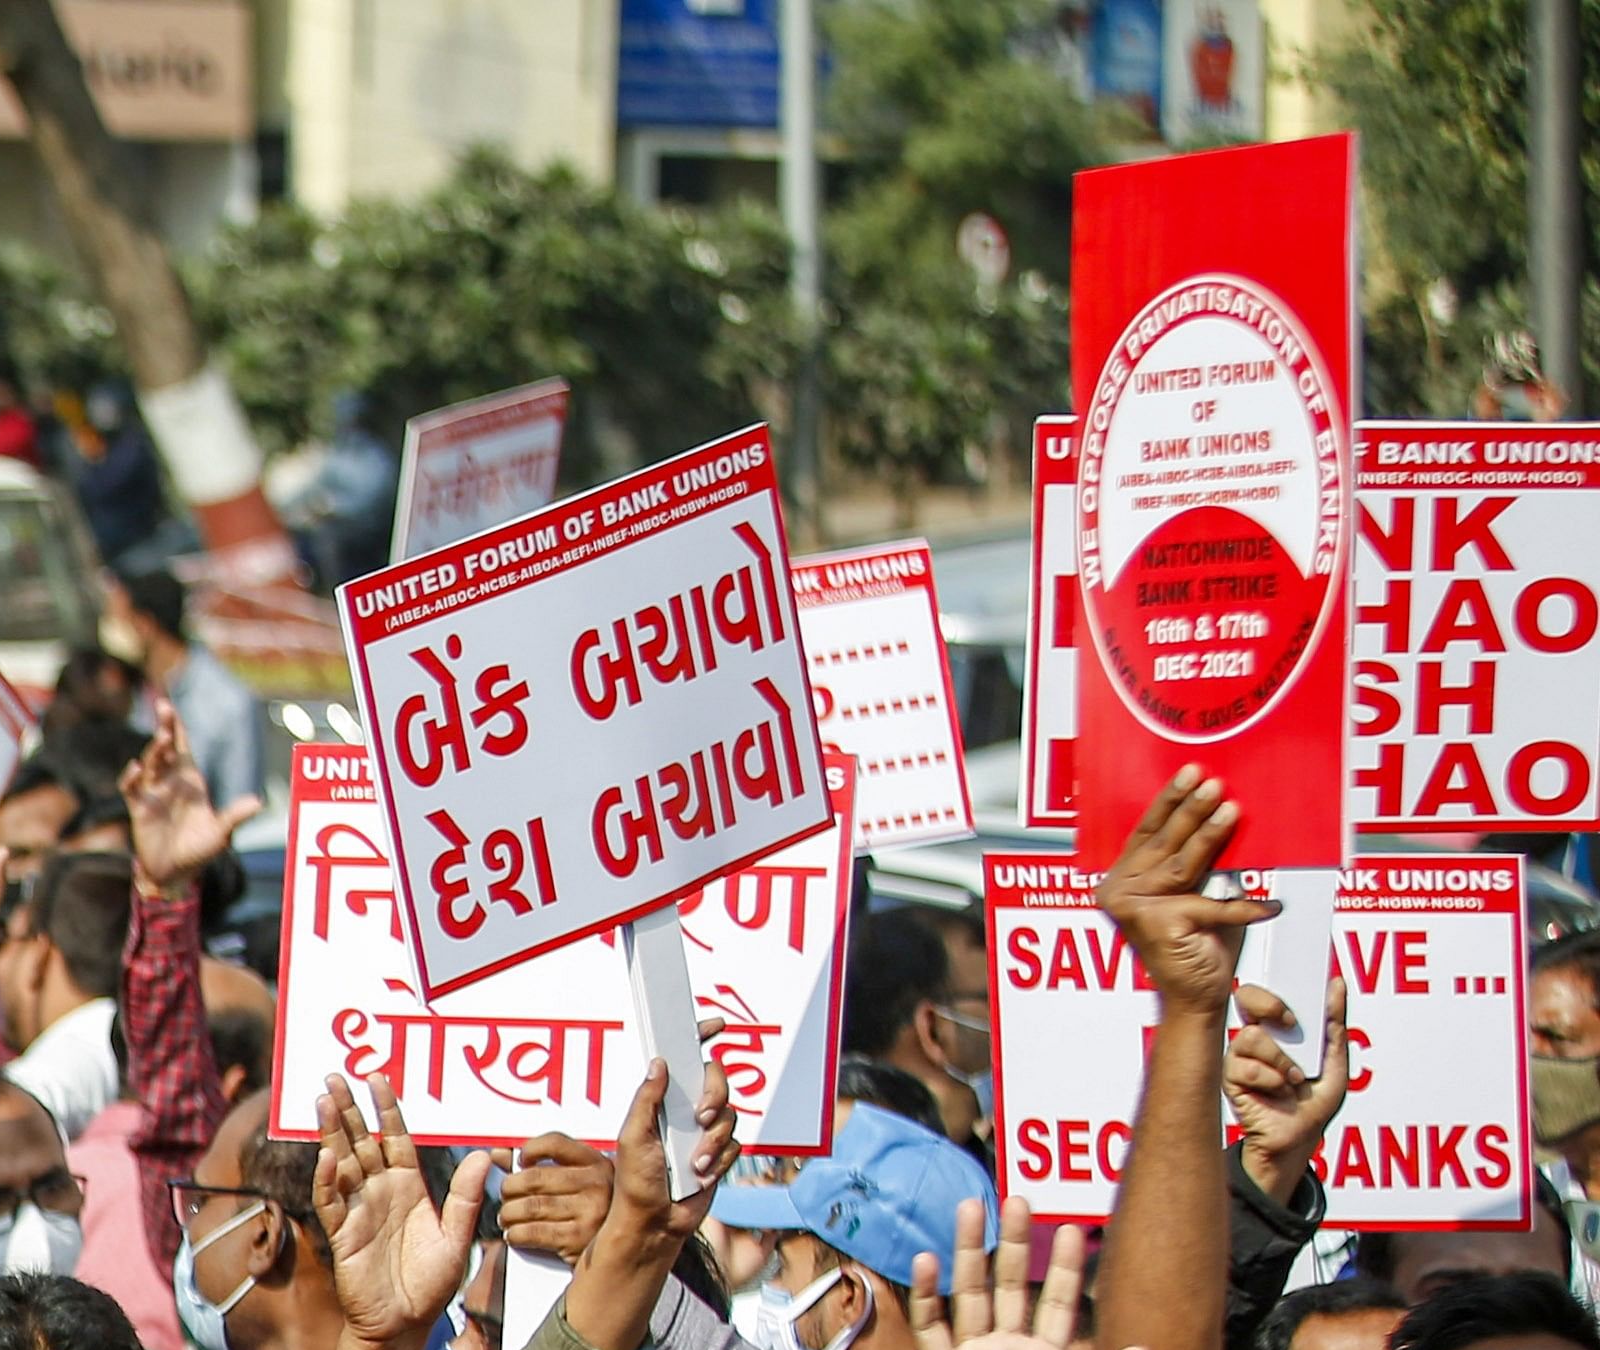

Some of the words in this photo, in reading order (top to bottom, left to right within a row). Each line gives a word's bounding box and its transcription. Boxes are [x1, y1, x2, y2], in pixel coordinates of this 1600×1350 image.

[1126, 287, 1301, 368] PRIVATISATION
[1135, 367, 1201, 394] UNITED
[1208, 360, 1274, 387] FORUM
[1299, 371, 1324, 416] OF
[1191, 400, 1216, 422] OF
[1081, 360, 1128, 513] OPPOSE
[1141, 440, 1190, 463] BANK
[1199, 431, 1271, 456] UNIONS
[1378, 441, 1476, 465] BANK
[1315, 429, 1339, 576] BANKS
[355, 562, 457, 619] UNITED
[463, 525, 557, 581] FORUM
[563, 510, 595, 541] OF
[600, 482, 670, 527] BANK
[673, 443, 767, 497] UNIONS
[1354, 496, 1521, 572] NK
[826, 552, 926, 588] UNIONS
[1081, 530, 1102, 591] WE
[1142, 537, 1274, 570] NATIONWIDE
[1137, 578, 1191, 607] BANK
[1199, 574, 1277, 601] STRIKE
[1145, 617, 1189, 644] 16th
[1193, 617, 1212, 641] &
[1216, 612, 1268, 639] 17th
[394, 632, 530, 788] બેંક
[570, 521, 786, 720] બચાવો
[1154, 653, 1196, 681] DEC
[1199, 650, 1255, 679] 2021
[1199, 697, 1247, 730] SAVE
[1354, 660, 1496, 737] SH
[302, 757, 374, 781] UNIT
[427, 808, 558, 940] દેશ
[591, 677, 805, 881] બચાવો
[1388, 869, 1514, 891] UNIONS
[331, 978, 625, 1107] धोखा
[695, 984, 782, 1117] है
